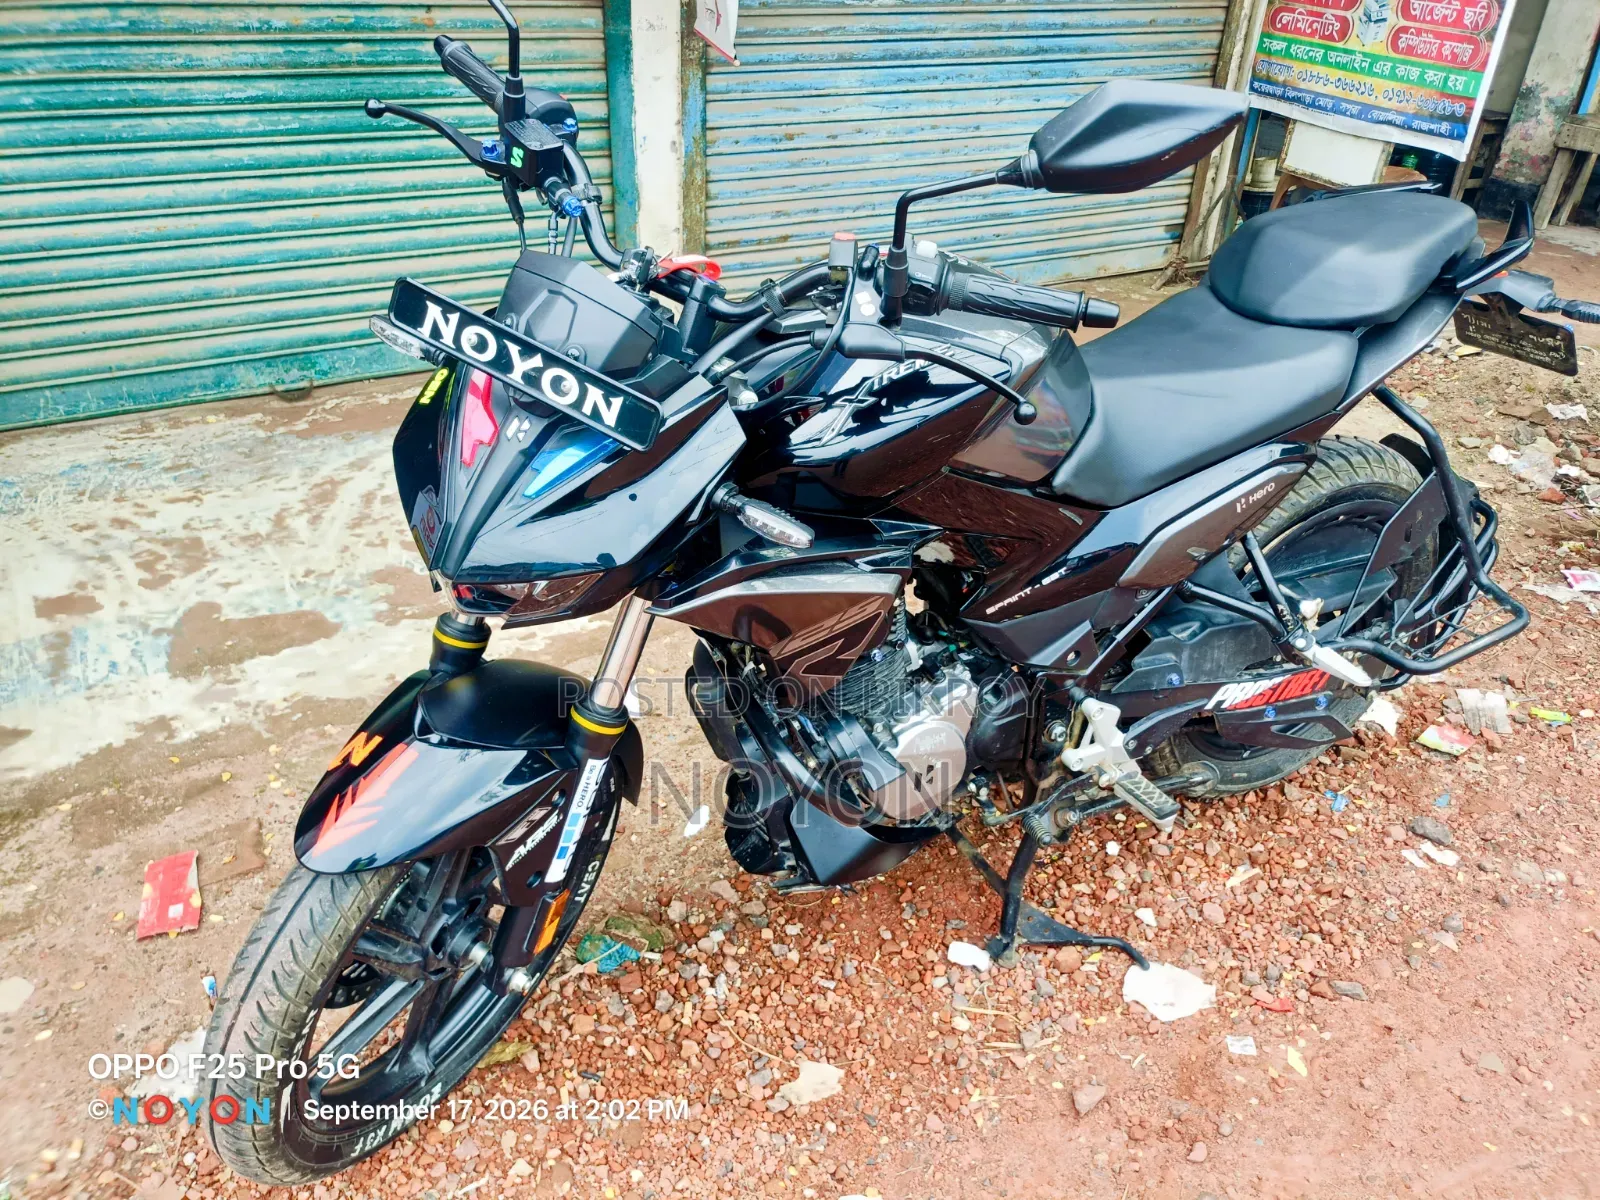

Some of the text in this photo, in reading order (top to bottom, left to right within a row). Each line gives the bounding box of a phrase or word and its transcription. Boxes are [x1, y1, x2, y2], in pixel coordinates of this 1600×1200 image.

[1464, 2, 1488, 29] ছবি
[1262, 38, 1288, 56] সকল
[1290, 43, 1325, 63] ধরনের
[1327, 50, 1371, 72] অনলাইন
[1373, 60, 1393, 77] এর
[1395, 64, 1422, 82] কাজ
[1424, 69, 1447, 88] করা
[417, 301, 624, 428] NOYON
[1248, 482, 1276, 504] Hero
